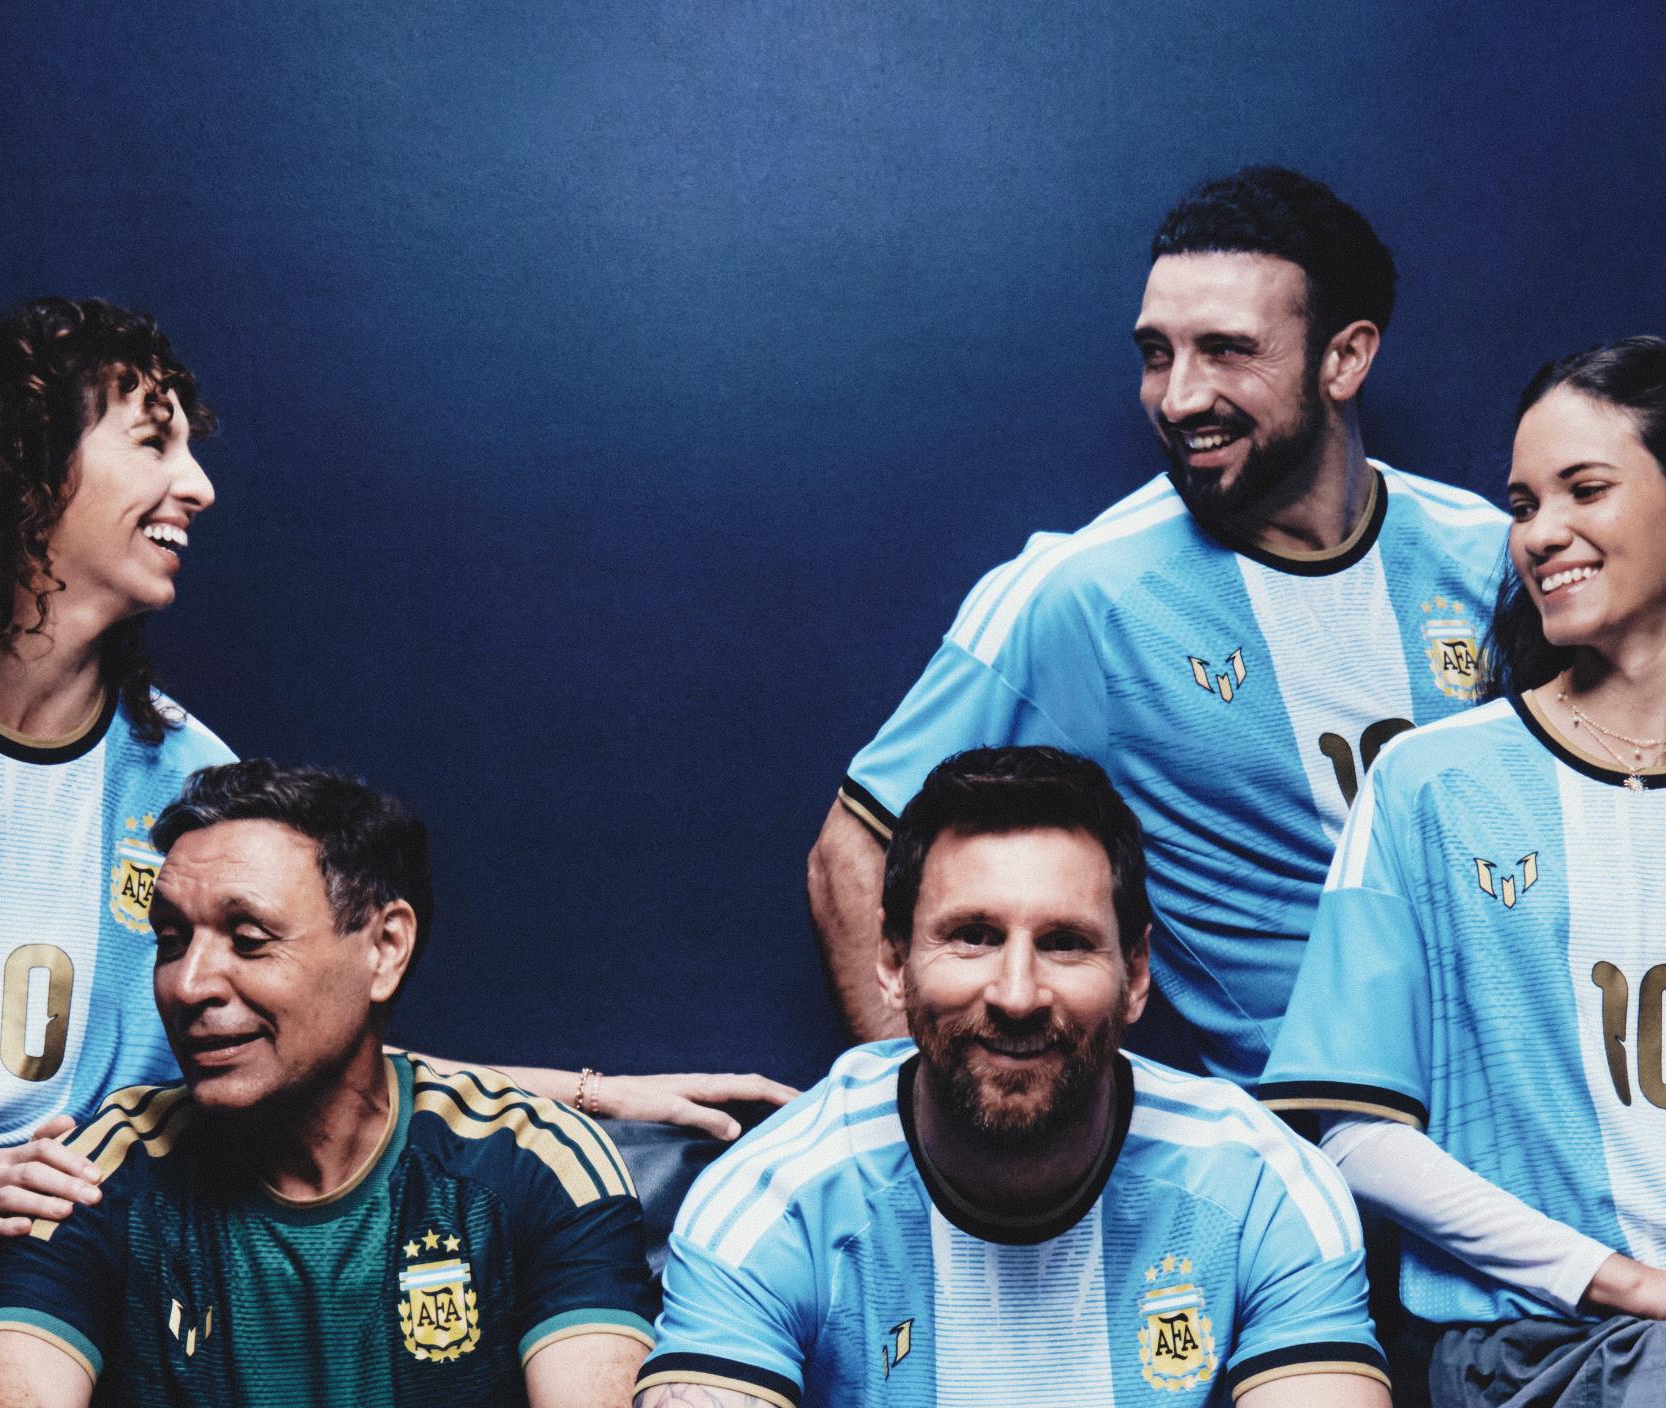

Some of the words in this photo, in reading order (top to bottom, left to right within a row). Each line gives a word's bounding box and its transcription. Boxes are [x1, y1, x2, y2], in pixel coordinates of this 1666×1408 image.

[1443, 641, 1478, 676] AFA
[416, 1287, 462, 1332] AFA
[1155, 1312, 1199, 1360] AFA
